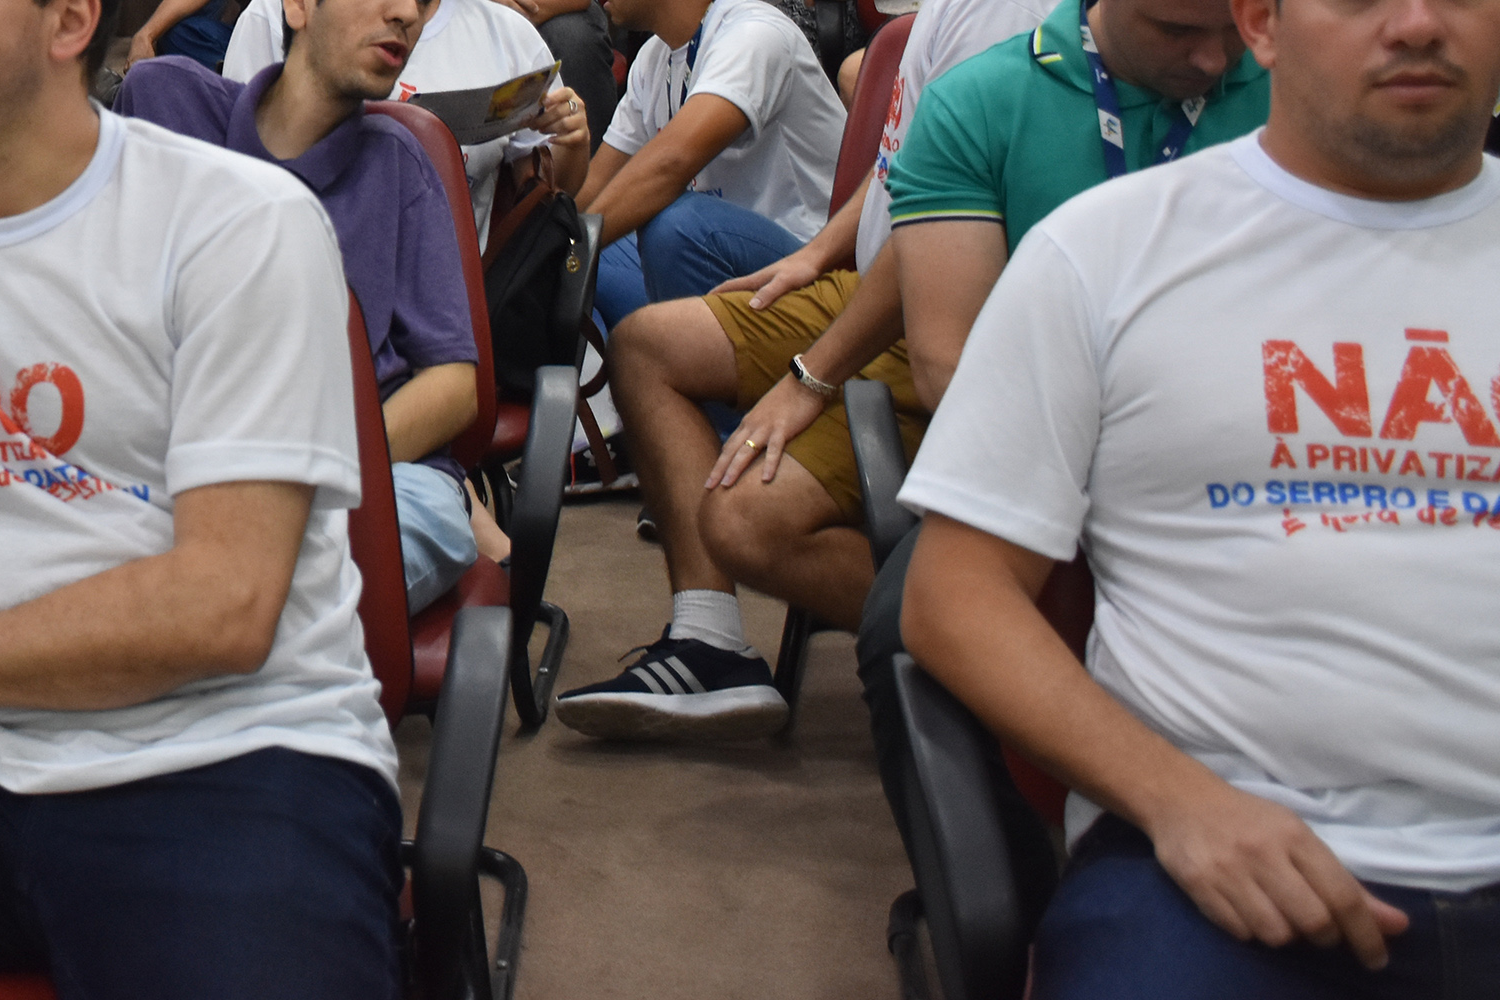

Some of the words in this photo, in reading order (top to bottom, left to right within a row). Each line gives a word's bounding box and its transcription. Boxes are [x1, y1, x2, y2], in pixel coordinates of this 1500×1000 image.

[1262, 327, 1500, 448] NÃ
[1270, 436, 1297, 469] À
[1206, 482, 1255, 509] DO
[1264, 480, 1417, 509] SERPRO
[1427, 488, 1450, 509] E
[1417, 504, 1458, 527] de
